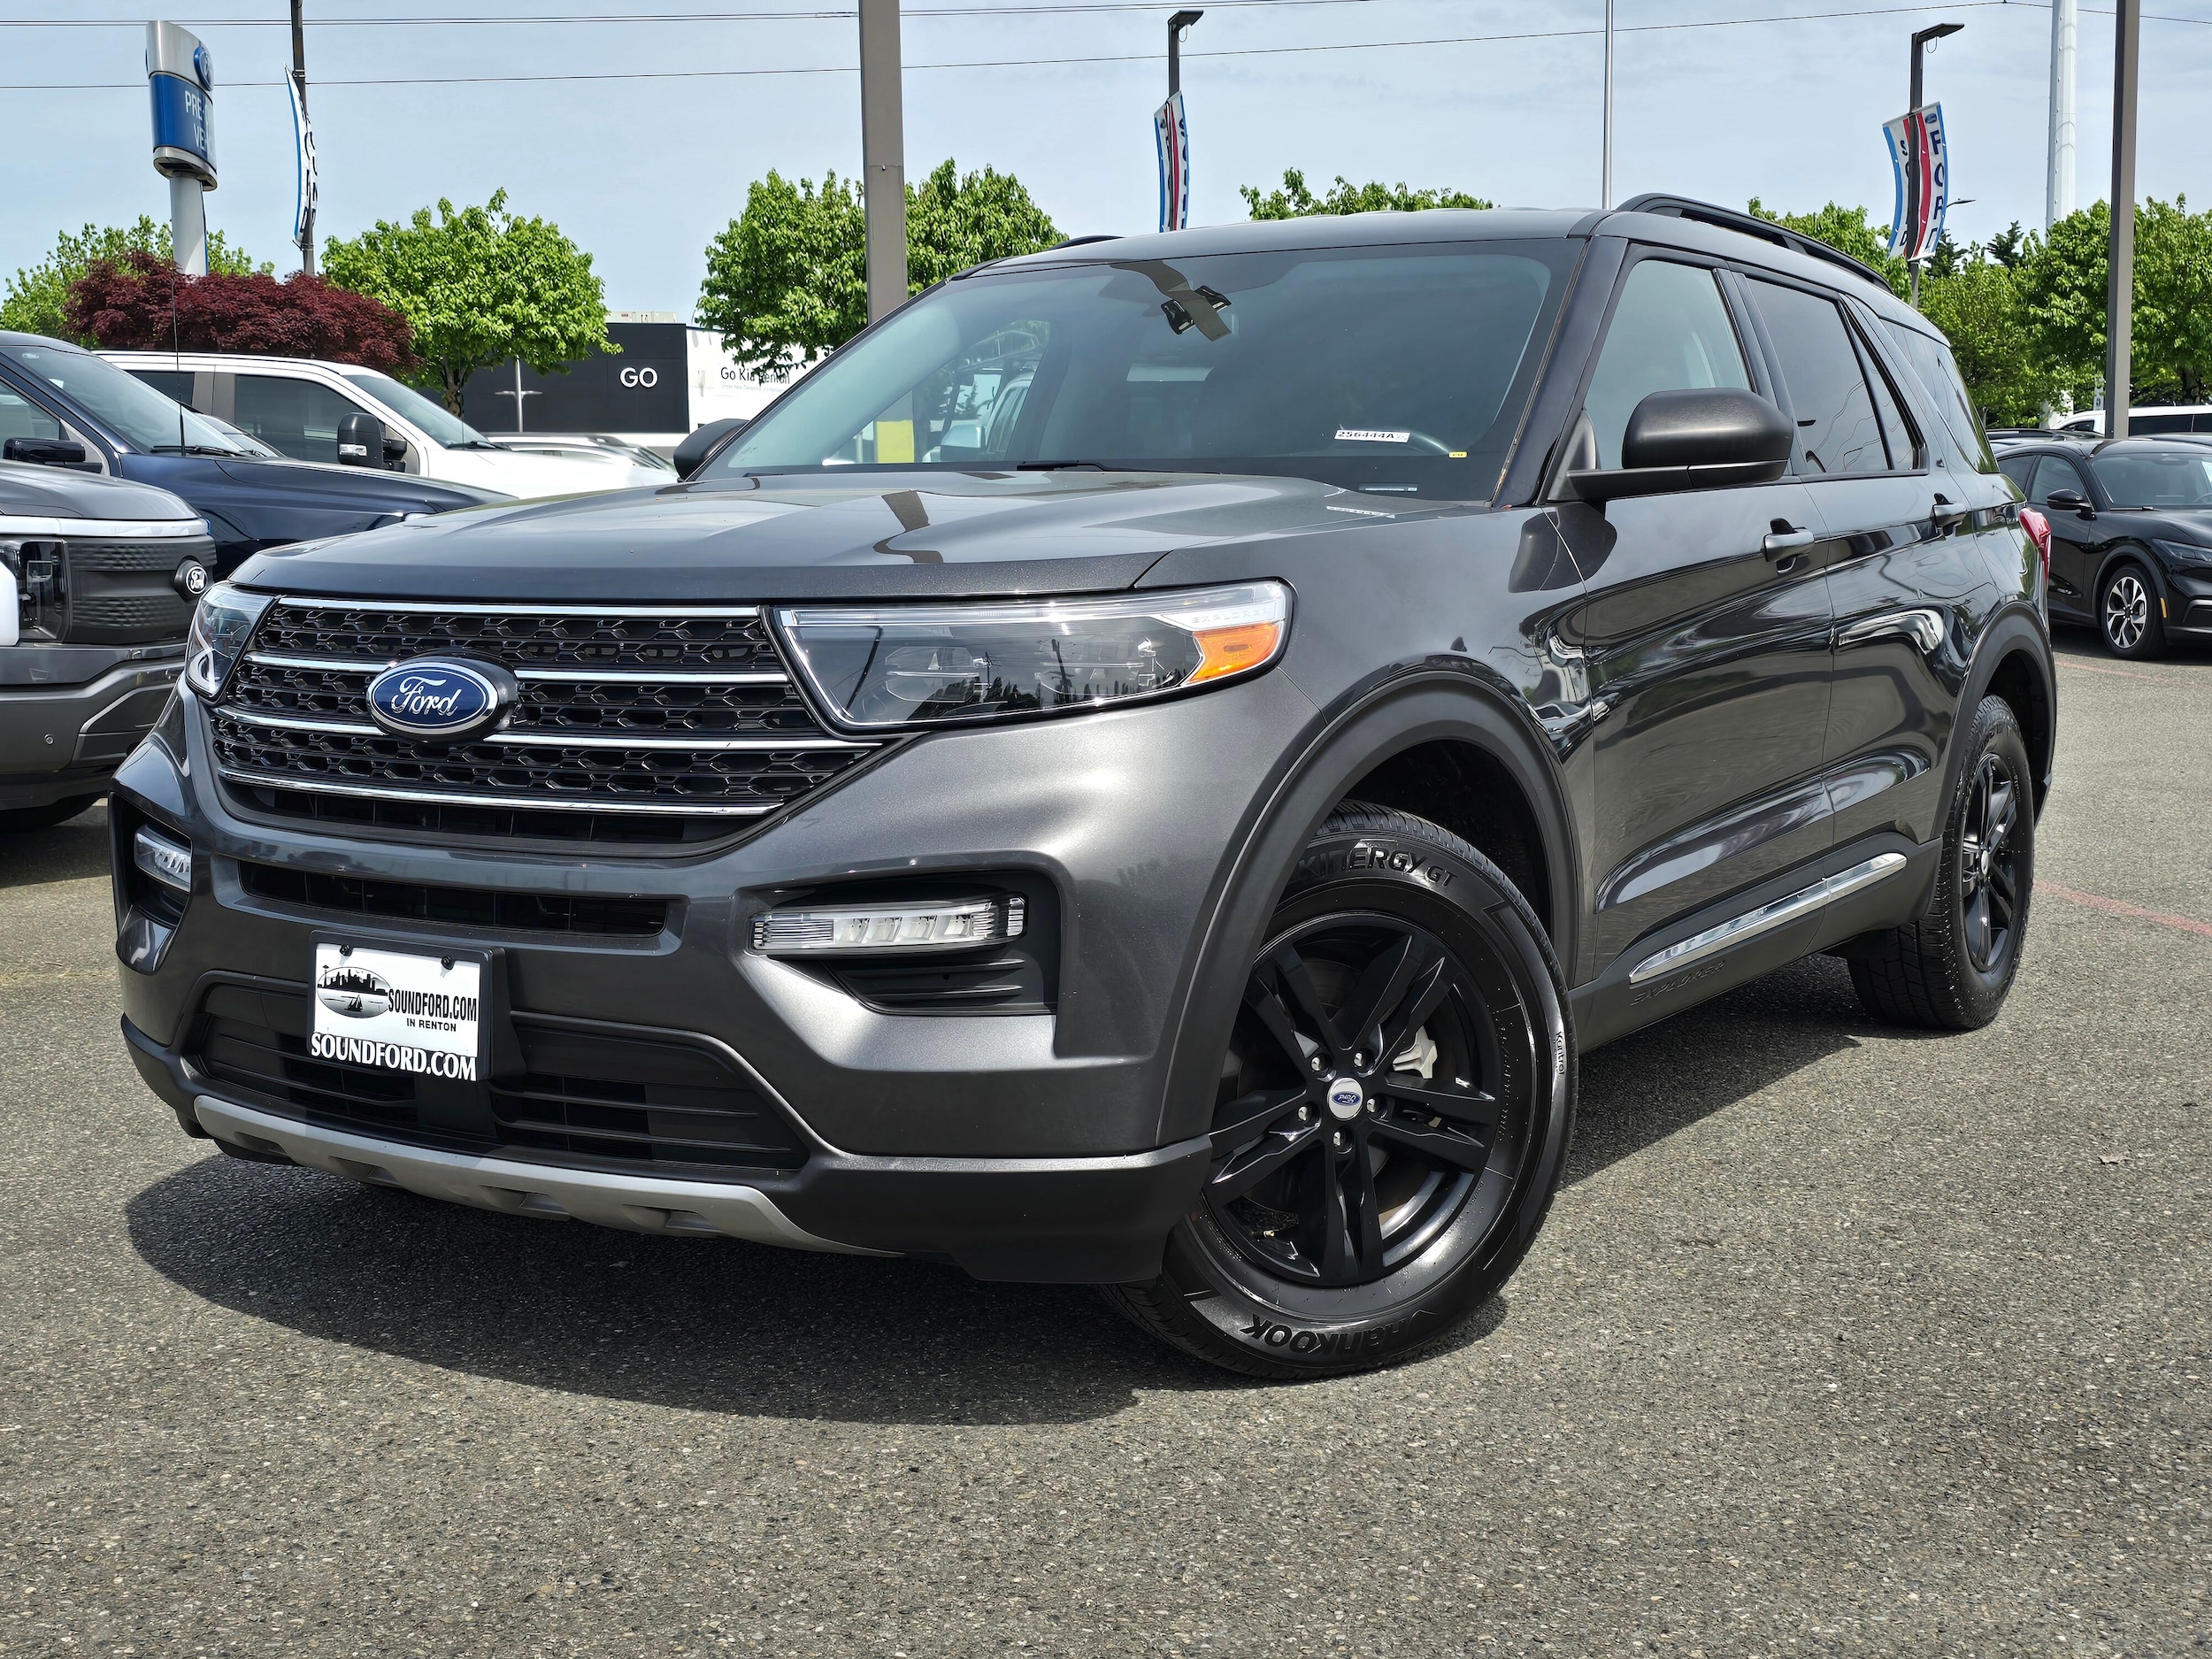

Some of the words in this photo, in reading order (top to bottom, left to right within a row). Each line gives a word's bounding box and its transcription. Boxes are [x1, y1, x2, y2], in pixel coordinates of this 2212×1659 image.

[619, 367, 658, 388] GO
[720, 366, 736, 380] Go
[739, 368, 756, 381] Kia
[391, 675, 463, 717] Ford
[1425, 864, 1458, 887] GT
[388, 988, 478, 1022] SOUNDFORD.COM
[406, 1018, 416, 1027] IN
[419, 1019, 457, 1033] RENTON
[311, 1032, 478, 1082] SOUNDFORD.COM
